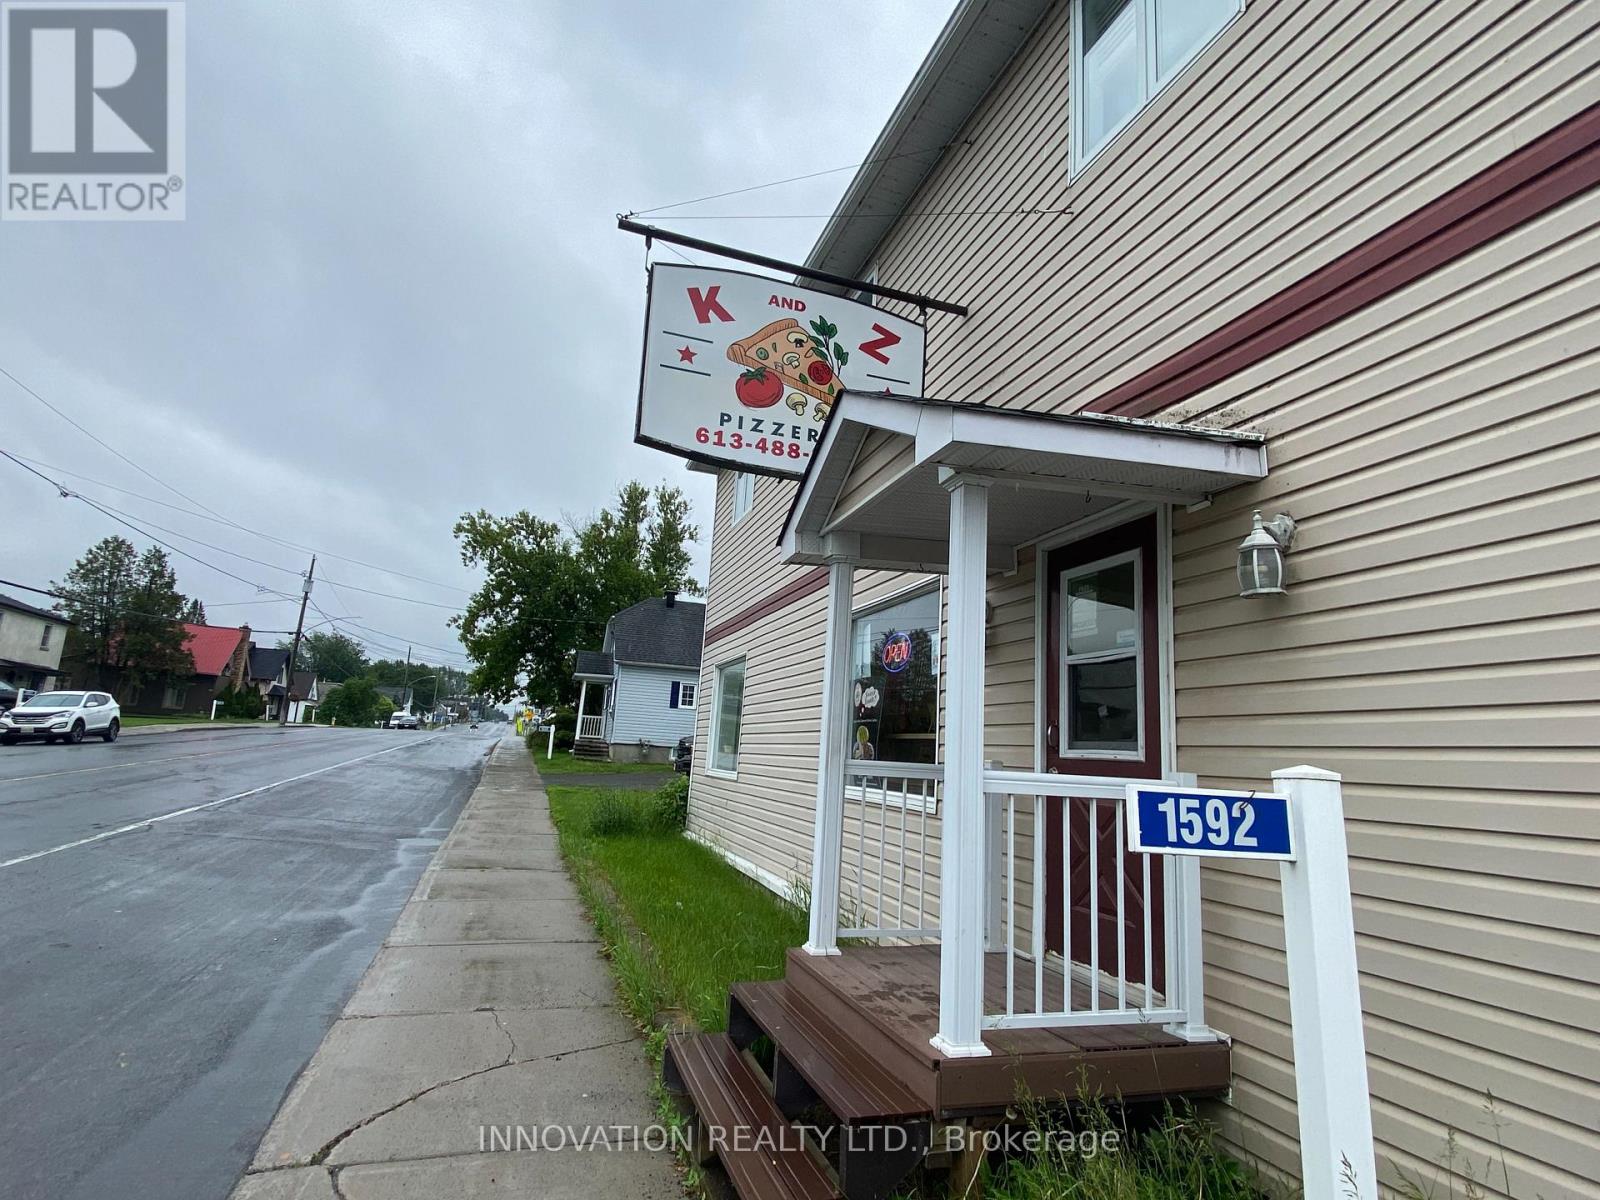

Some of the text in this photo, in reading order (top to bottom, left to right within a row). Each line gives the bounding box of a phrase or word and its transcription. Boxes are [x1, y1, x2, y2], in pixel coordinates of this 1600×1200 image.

[687, 286, 901, 365] K AND Z
[884, 641, 909, 663] OPEN
[1158, 797, 1258, 847] 1592
